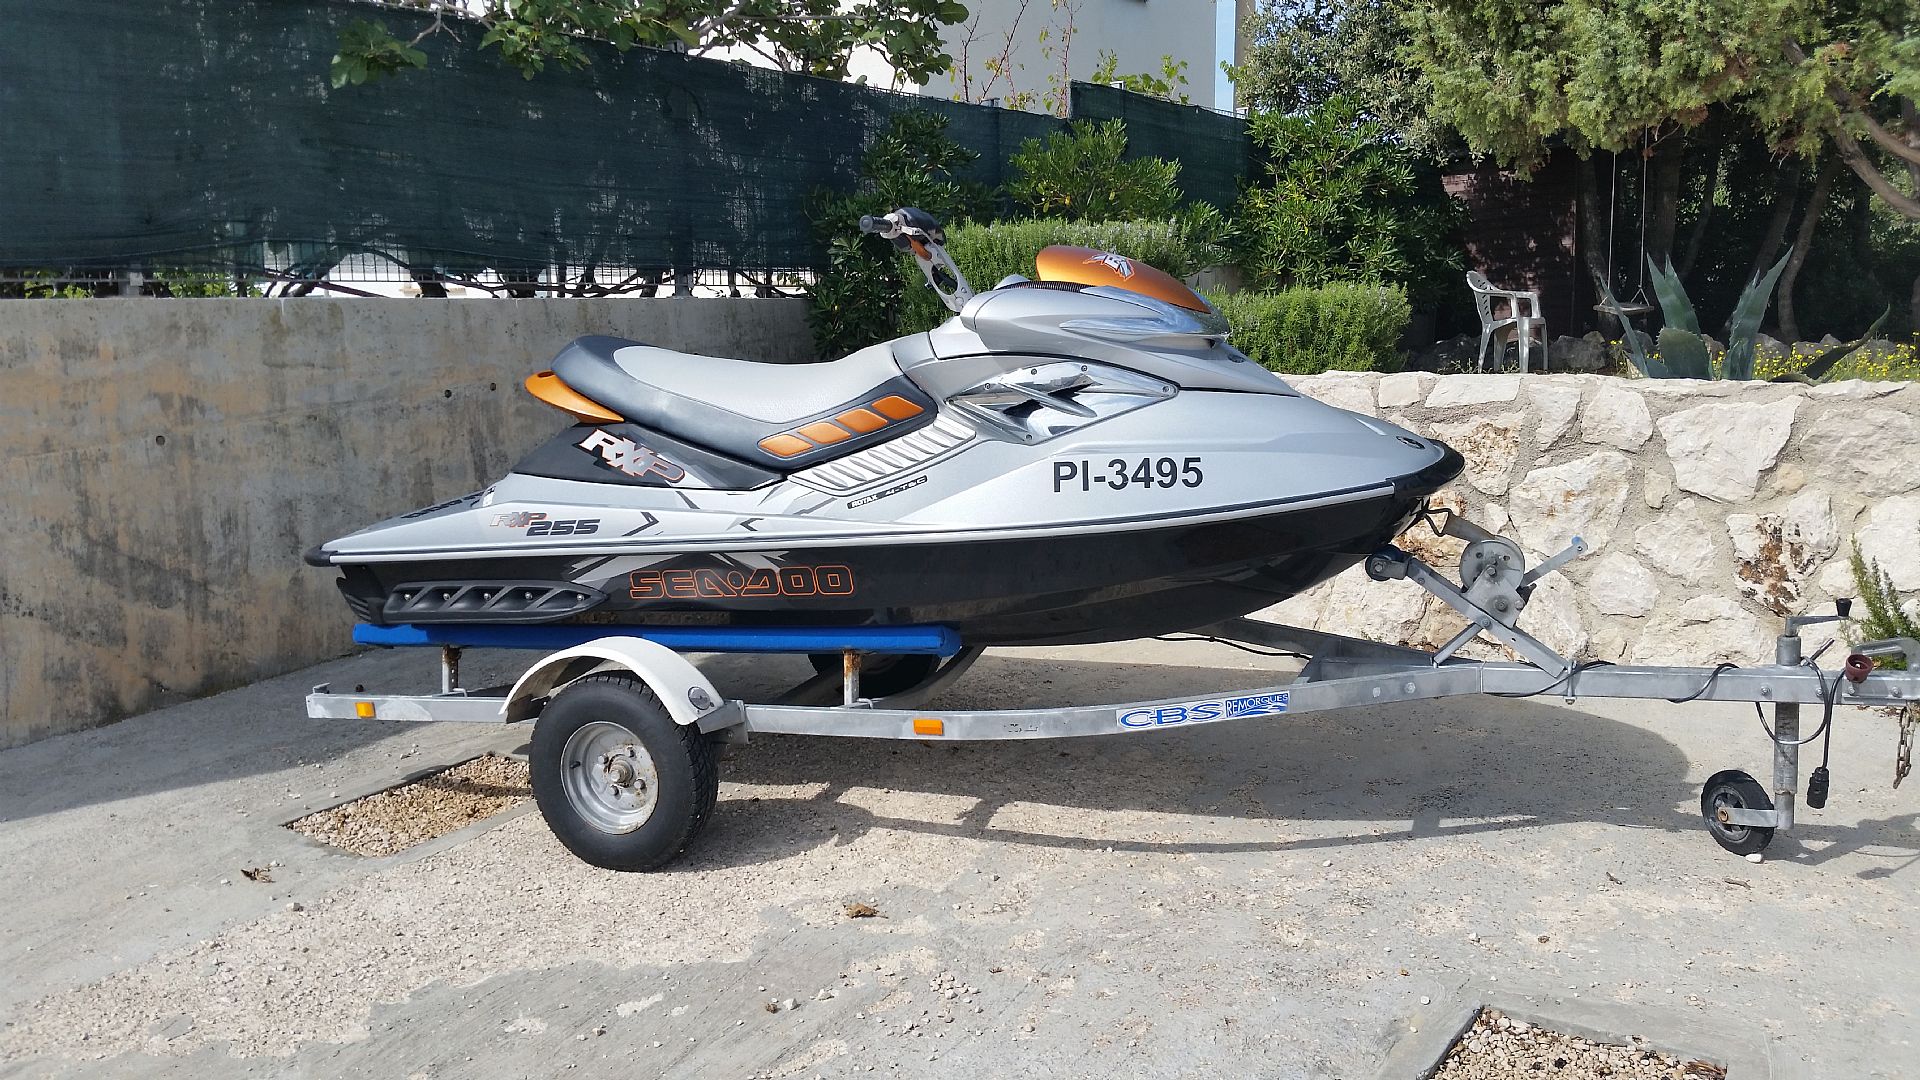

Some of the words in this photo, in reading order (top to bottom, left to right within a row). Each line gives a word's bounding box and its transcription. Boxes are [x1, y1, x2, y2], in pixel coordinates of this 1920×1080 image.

[579, 430, 685, 482] RXP
[1053, 456, 1204, 493] PI-3495
[851, 494, 878, 508] ROTAX
[490, 511, 547, 527] RXP
[526, 519, 601, 536] 255
[1120, 702, 1223, 728] CBS
[1226, 693, 1289, 718] REMORQUES
